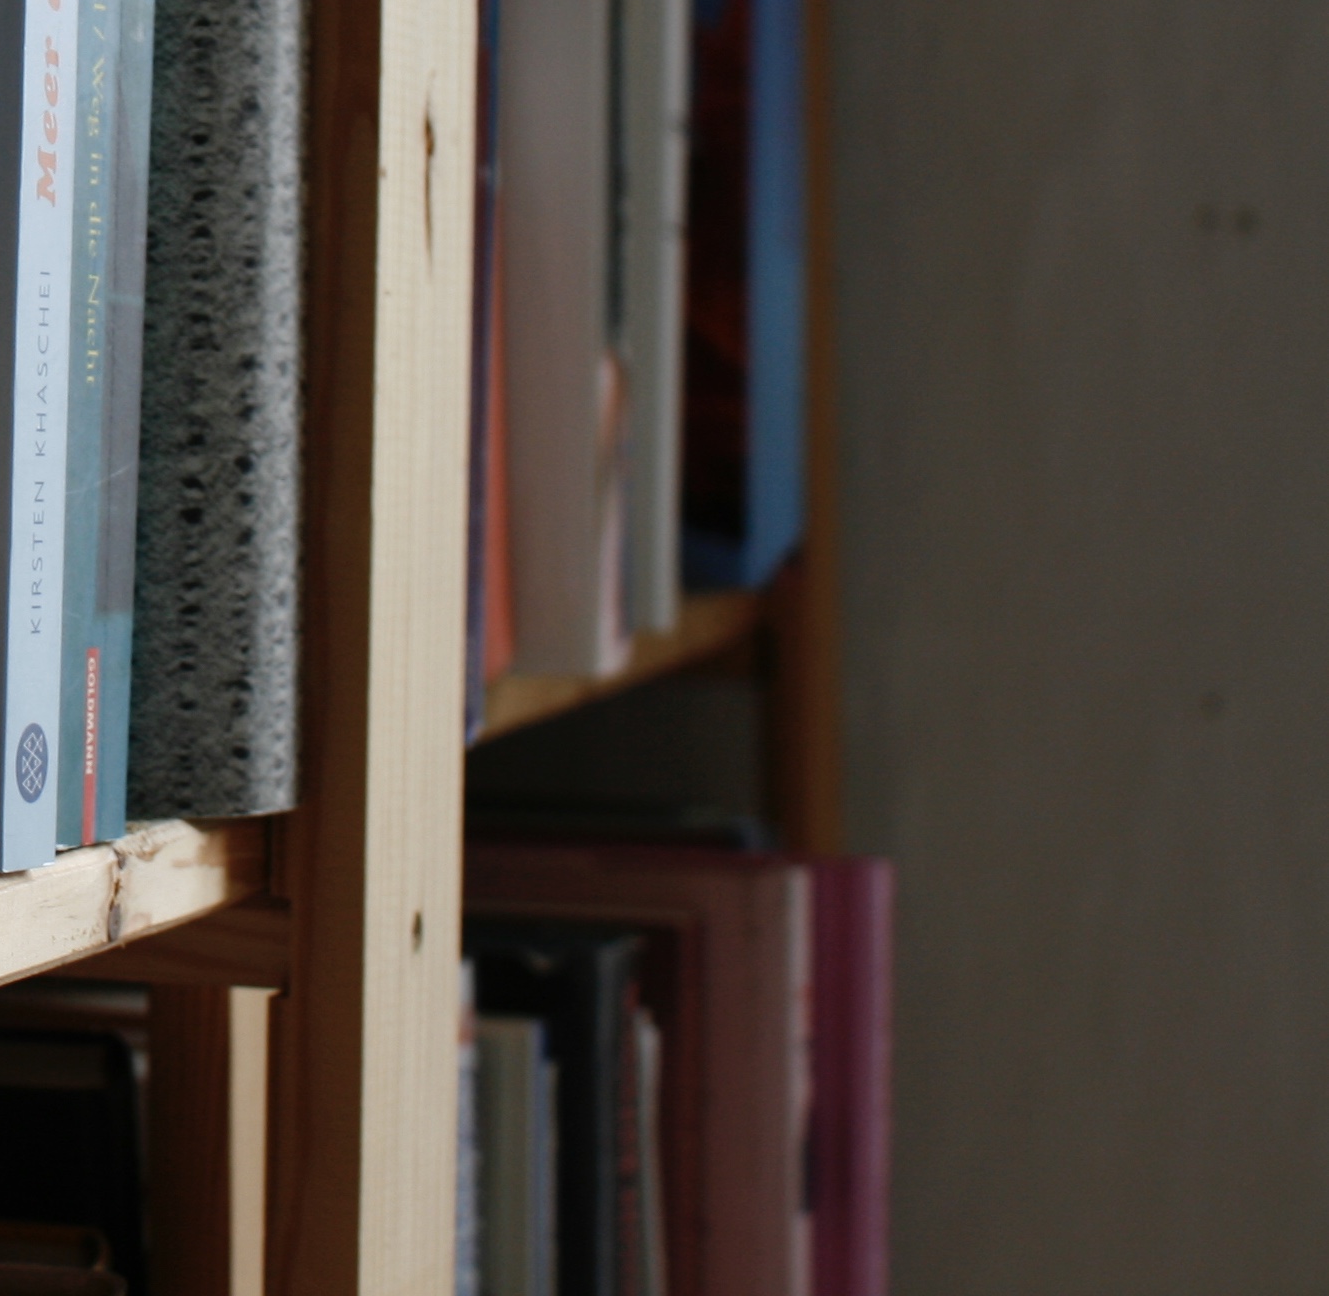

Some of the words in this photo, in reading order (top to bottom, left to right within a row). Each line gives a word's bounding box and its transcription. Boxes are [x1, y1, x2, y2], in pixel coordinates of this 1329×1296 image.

[35, 35, 61, 209] Meer
[87, 56, 105, 138] Weg
[88, 200, 102, 259] die
[34, 269, 52, 459] KHASCHEI
[85, 273, 101, 389] Nacht
[29, 480, 45, 636] KIRSTEN
[85, 657, 97, 775] GOLDMANN
